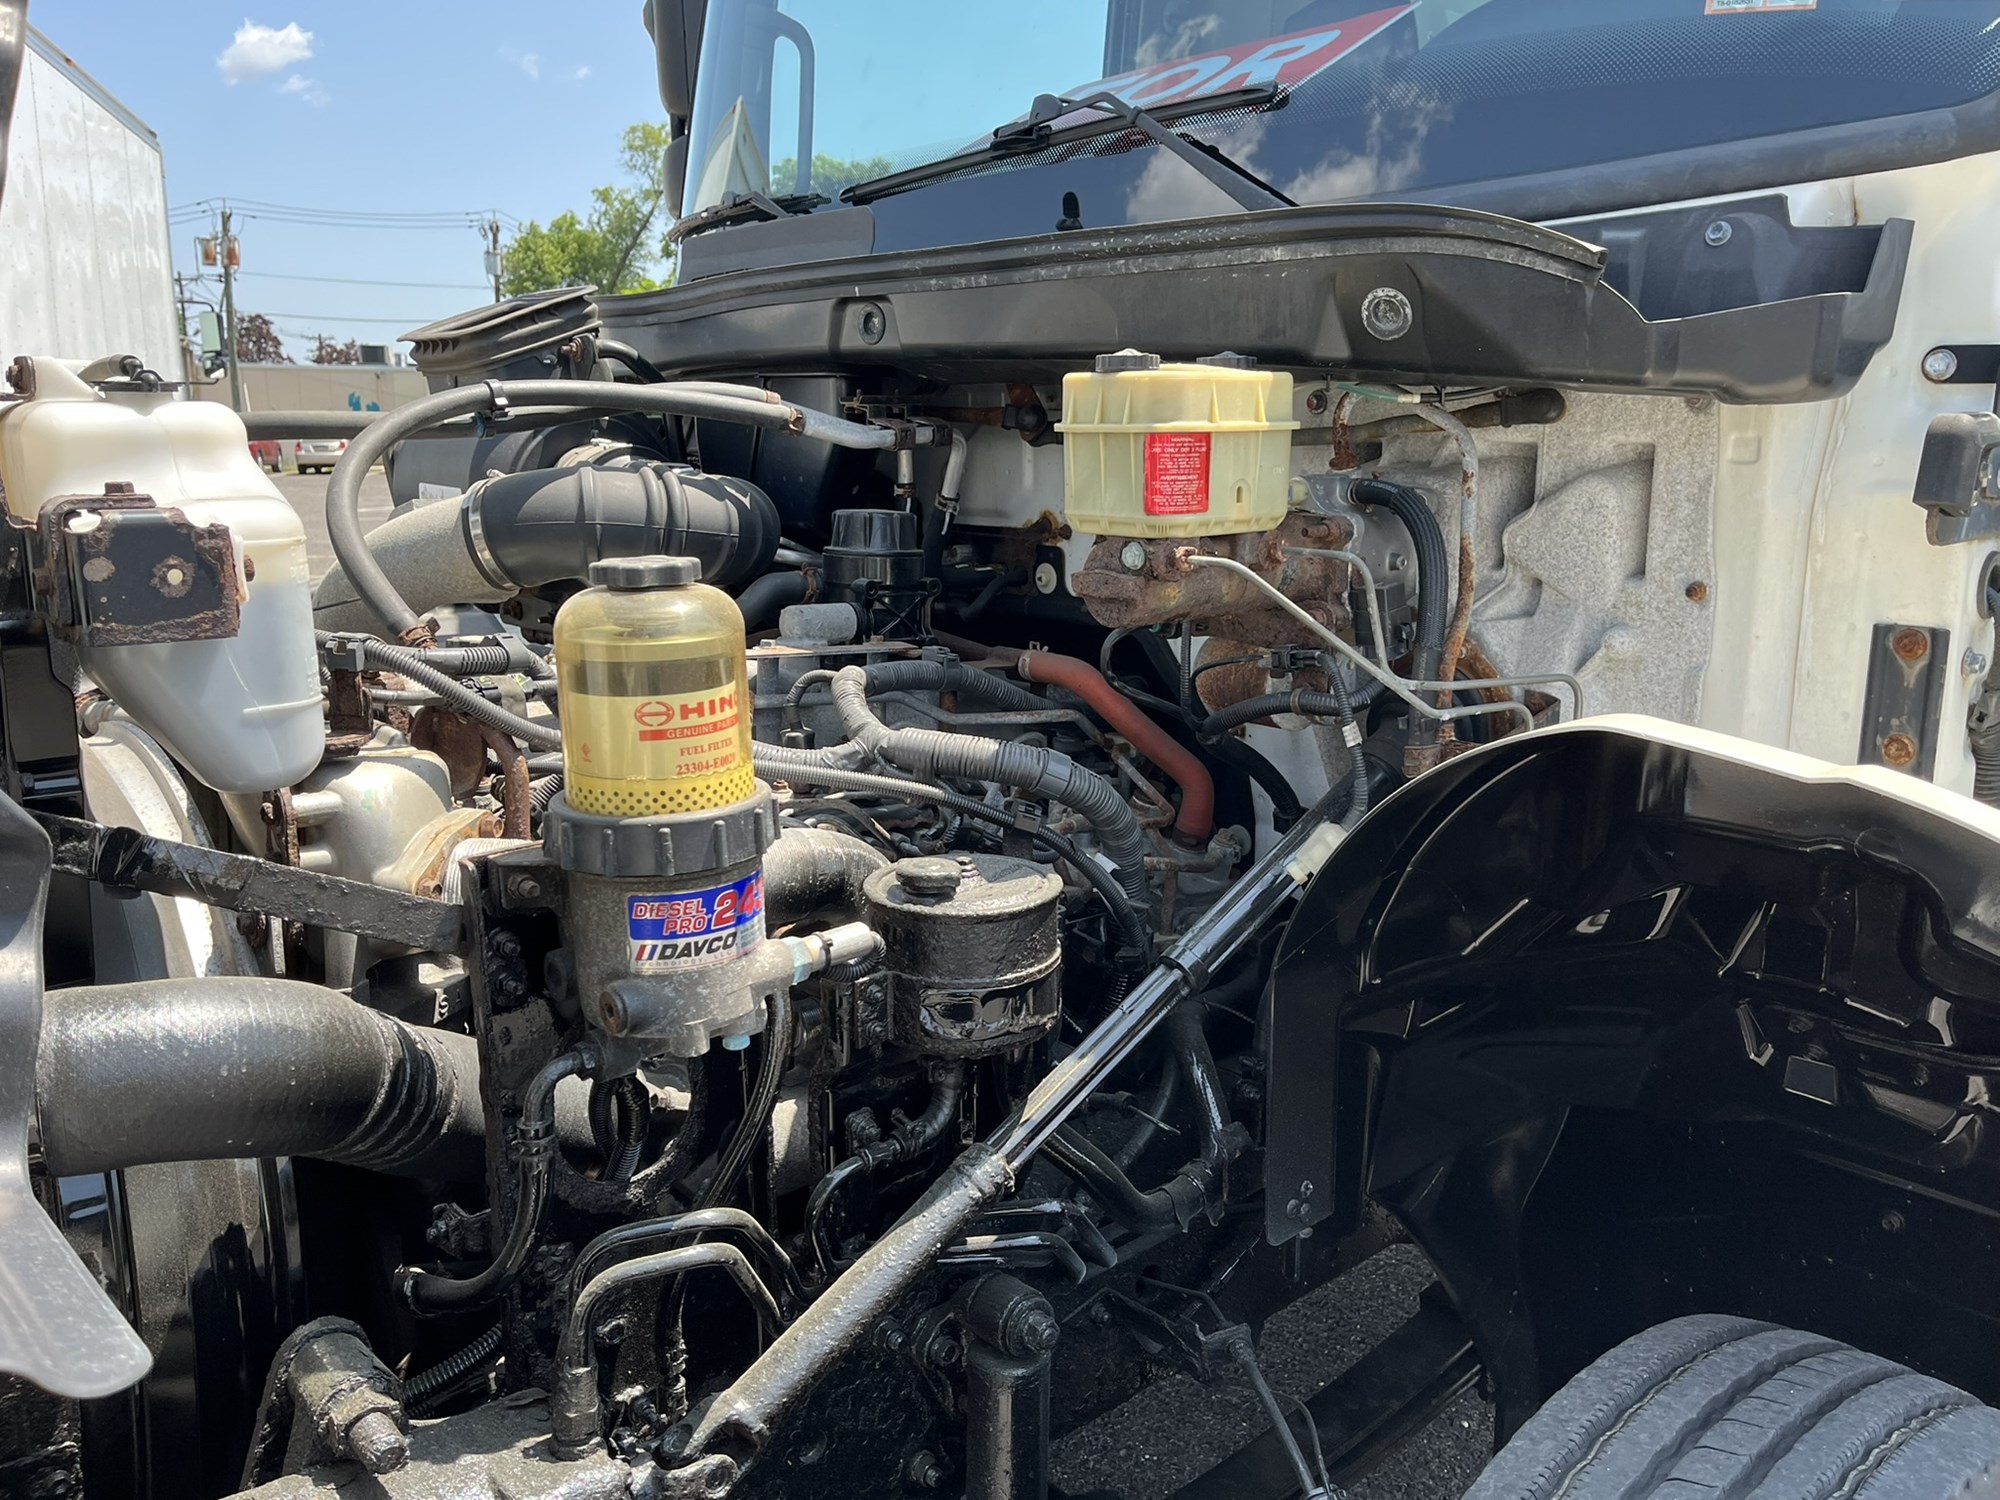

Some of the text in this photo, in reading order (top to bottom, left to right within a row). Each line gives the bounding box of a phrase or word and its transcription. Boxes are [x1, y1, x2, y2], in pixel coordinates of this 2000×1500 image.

[667, 723, 714, 738] GENUINE
[680, 745, 706, 756] FUEL
[632, 898, 706, 919] DIESEL
[663, 915, 708, 936] PRO
[657, 932, 738, 960] DAVCO
